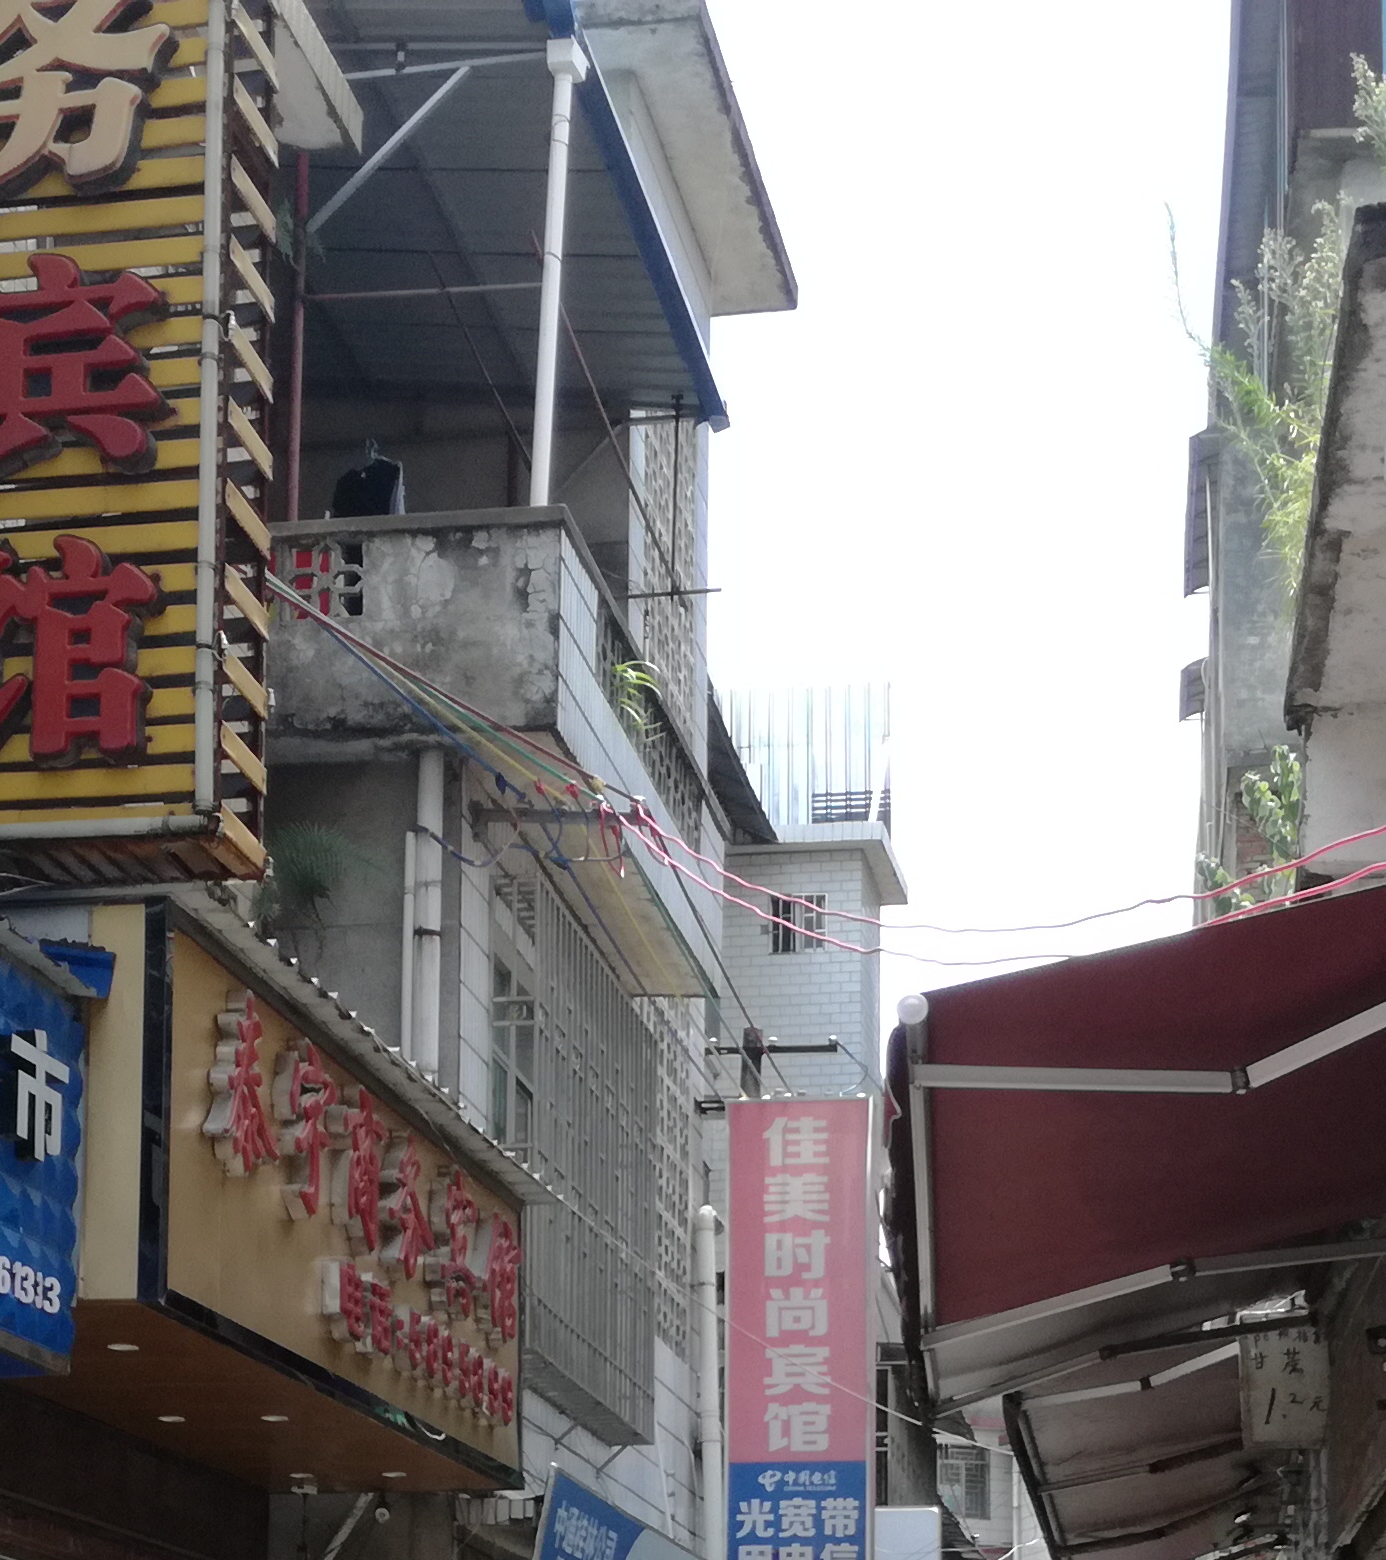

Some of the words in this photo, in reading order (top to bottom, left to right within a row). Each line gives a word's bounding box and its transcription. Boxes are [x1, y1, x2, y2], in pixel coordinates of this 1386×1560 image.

[763, 1115, 831, 1454] 佳美时尚宾馆
[782, 1469, 837, 1486] 中国电信
[735, 1496, 859, 1538] 光宽带
